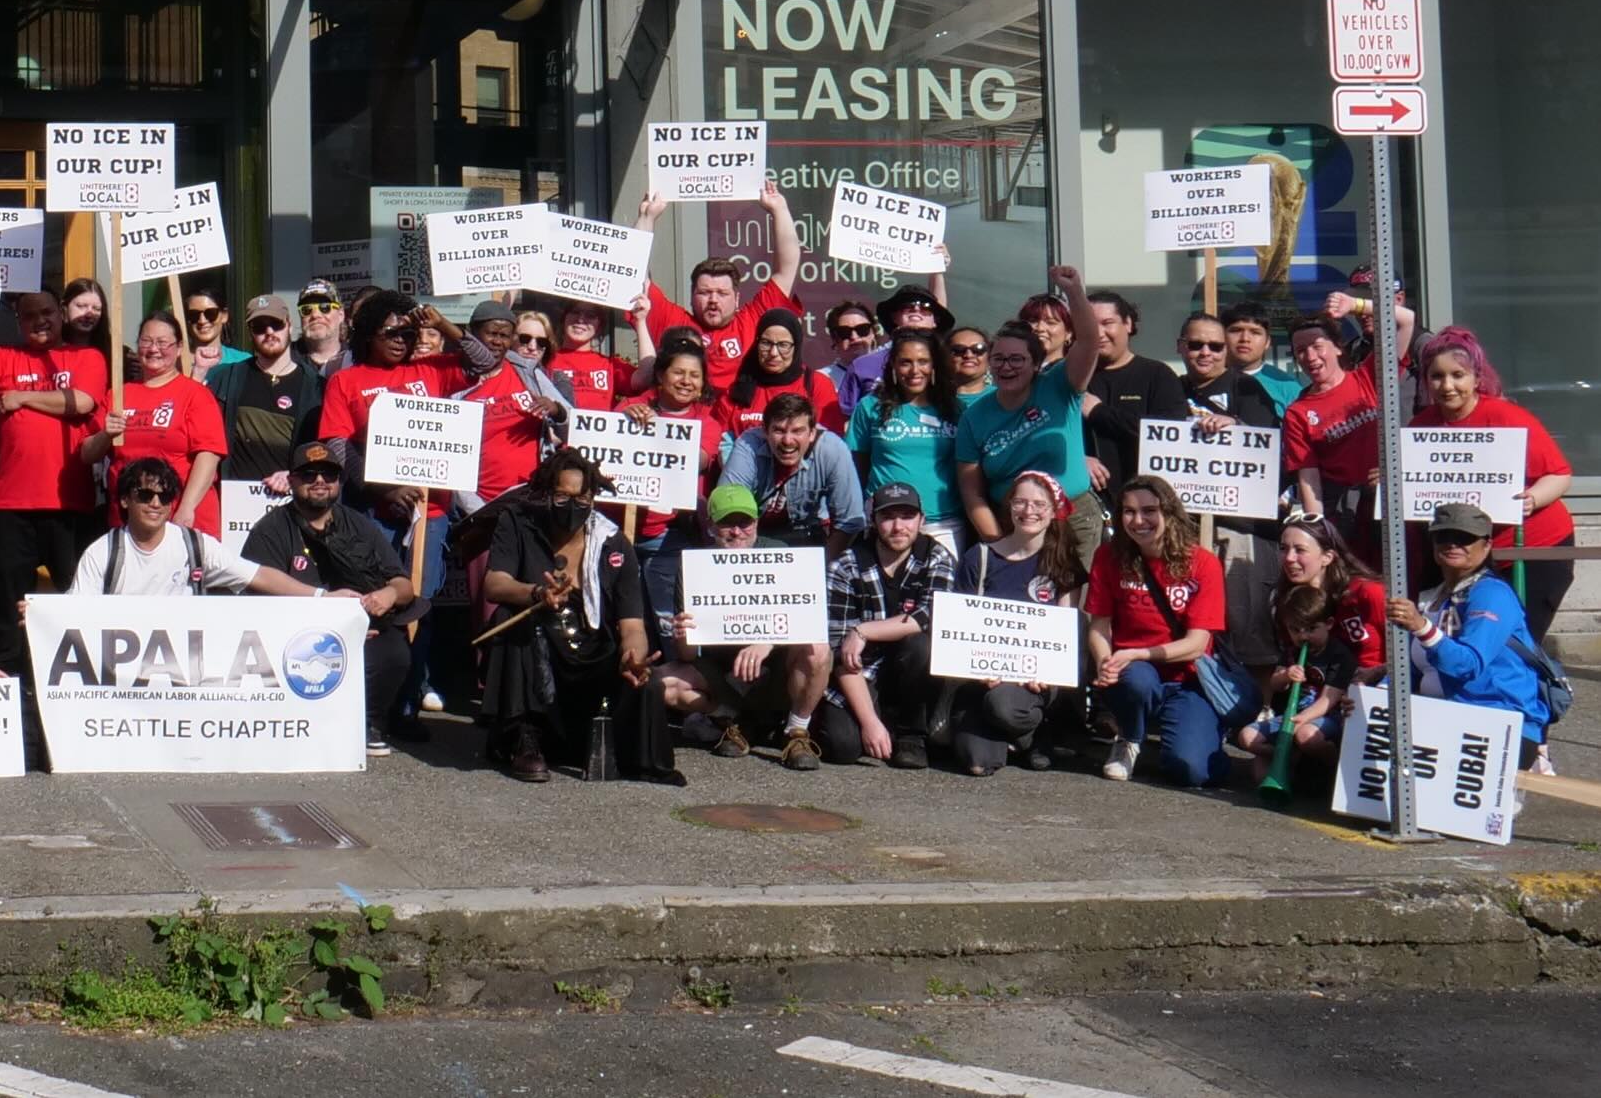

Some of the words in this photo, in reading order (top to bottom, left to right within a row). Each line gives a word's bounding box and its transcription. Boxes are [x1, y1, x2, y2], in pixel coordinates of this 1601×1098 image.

[1342, 15, 1408, 30] VEHICLES
[1359, 35, 1393, 49] OVER
[1343, 54, 1381, 69] 10,000
[1387, 53, 1411, 69] GVW
[724, 67, 1017, 121] LEASING
[53, 129, 82, 144] NO
[94, 129, 130, 144] ICE
[141, 129, 166, 144] IN
[654, 128, 681, 141] NO
[691, 127, 726, 141] ICE
[735, 126, 759, 141] IN
[57, 159, 101, 174] OUR
[110, 159, 162, 174] CUP!
[657, 154, 699, 168] OUR
[708, 153, 754, 167] CUP!
[766, 162, 855, 188] eative
[864, 161, 960, 188] Office
[1170, 169, 1241, 183] WORKERS
[189, 189, 211, 206] IN
[1187, 188, 1225, 198] OVER
[840, 187, 867, 205] NO
[875, 196, 910, 215] ICE
[918, 205, 941, 222] IN
[1151, 204, 1260, 219] BILLIONAIRES!
[454, 210, 523, 225] WORKERS
[471, 230, 509, 241] OVER
[561, 219, 628, 240] WORKERS
[840, 215, 879, 235] OUR
[888, 225, 933, 247] CUP!
[438, 244, 543, 262] BILLIONAIRES!
[573, 239, 608, 254] OVER
[551, 252, 638, 278] LLIONAIRES!
[727, 255, 898, 289] Coorking
[722, 338, 741, 358] 8
[395, 398, 460, 414] WORKERS
[152, 408, 173, 428] 8
[407, 420, 443, 432] OVER
[576, 415, 606, 432] NO
[617, 419, 656, 437] ICE
[666, 423, 693, 440] IN
[374, 435, 473, 455] BILLIONAIRES!
[1146, 426, 1179, 442] NO
[1190, 427, 1231, 445] ICE
[1243, 432, 1272, 449] IN
[1413, 432, 1495, 443] WORKERS
[1430, 452, 1473, 463] OVER
[1150, 456, 1198, 474] OUR
[1208, 460, 1266, 479] CUP!
[1403, 472, 1513, 484] LLIONAIRES!
[1180, 493, 1220, 506] OCAL
[712, 553, 794, 564] WORKERS
[732, 574, 776, 585] OVER
[691, 594, 817, 607] BILLIONAIRES!
[965, 599, 1046, 617] WORKERS
[983, 617, 1027, 631] OVER
[941, 629, 1068, 652] BILLIONAIRES!
[47, 629, 280, 687] APALA
[47, 692, 72, 700] ASIAN
[74, 691, 109, 700] PACIFIC
[111, 691, 164, 700] AMERICAN
[166, 692, 197, 701] LABOR
[200, 693, 247, 702] ALLIANCE,
[250, 693, 285, 702] AFL-CIO
[304, 684, 325, 694] APALA
[84, 719, 191, 738] SEATTLE
[201, 720, 310, 738] CHAPTER
[1364, 706, 1391, 765] WAR
[1453, 733, 1490, 810] CUBA!
[1358, 767, 1387, 801] NO
